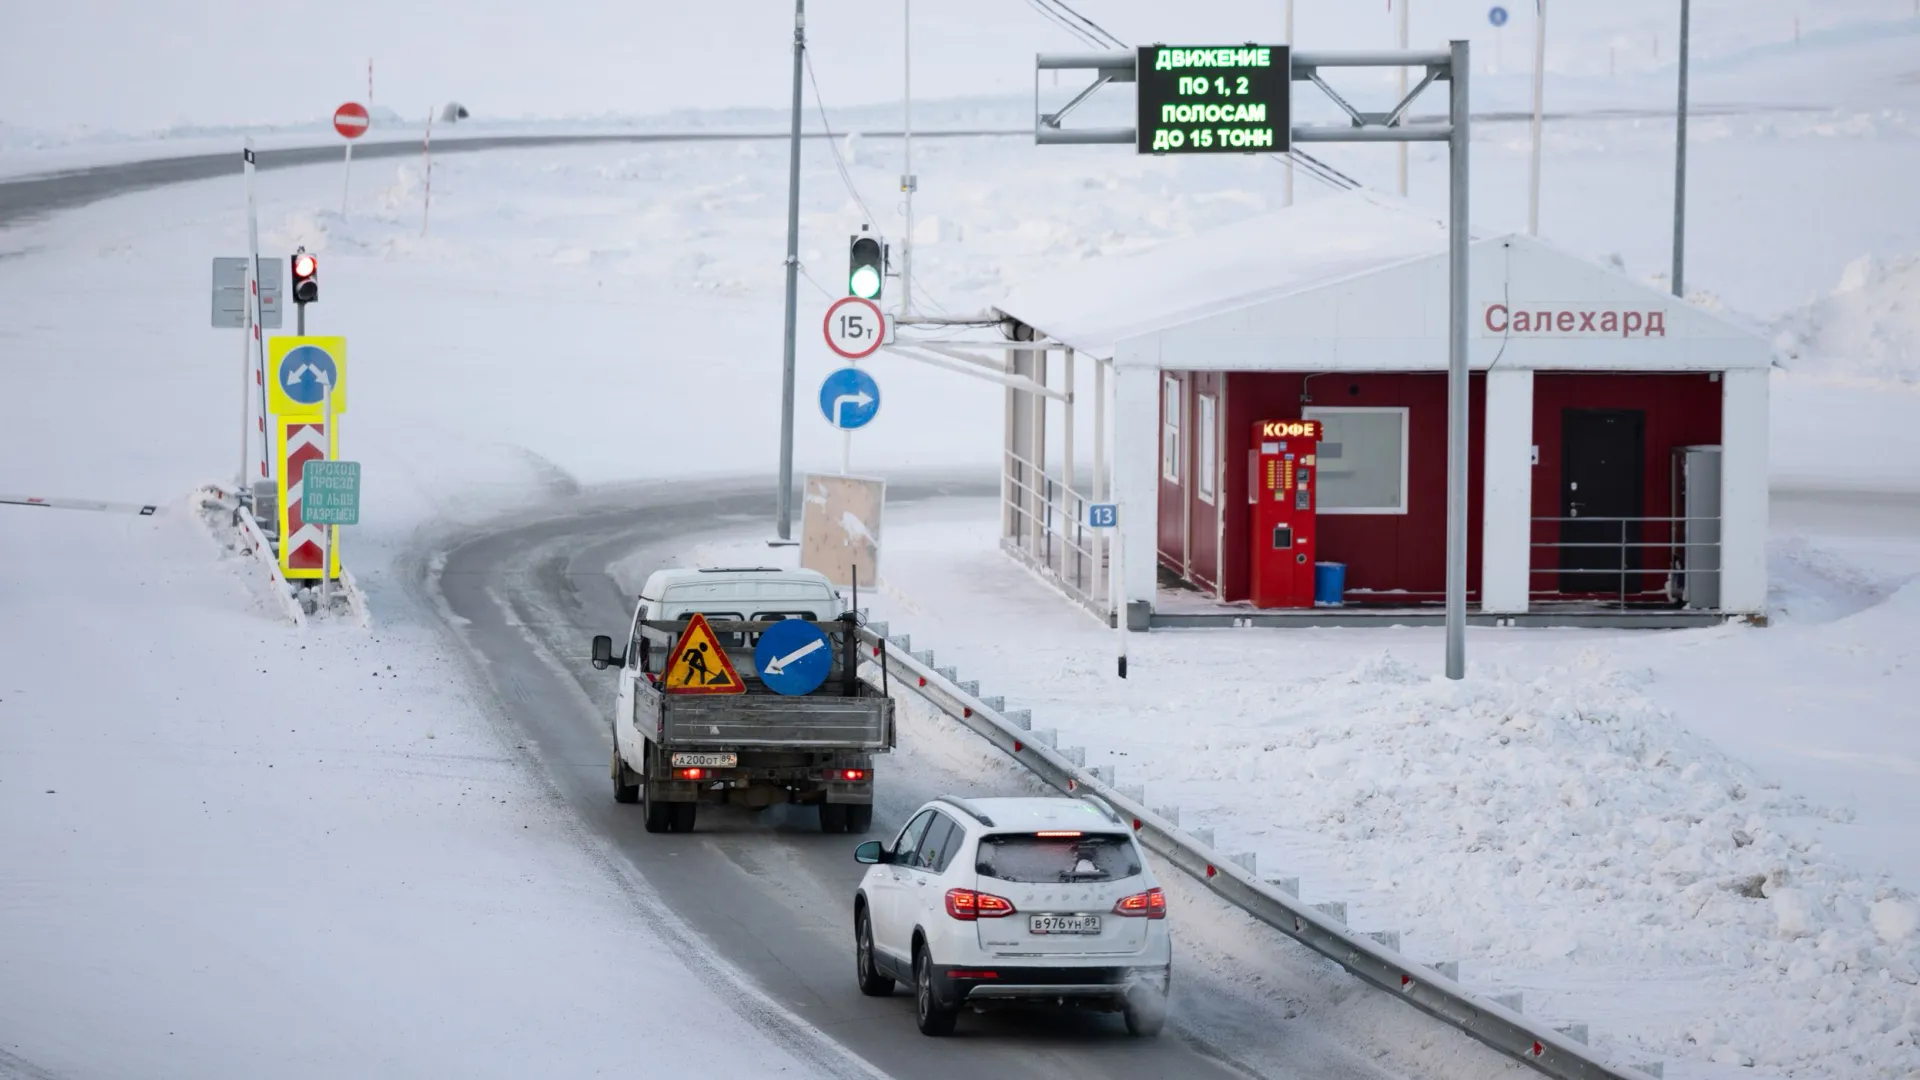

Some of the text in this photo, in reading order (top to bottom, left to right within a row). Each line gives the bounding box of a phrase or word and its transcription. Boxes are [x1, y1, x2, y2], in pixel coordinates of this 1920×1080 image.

[1155, 48, 1271, 71] ДВИЖЕНИЕ
[1178, 76, 1249, 97] ПО 1, 2
[1162, 103, 1266, 123] ПОЛОСАМ
[1152, 128, 1273, 150] ДО 15 ТОНН
[1485, 304, 1665, 338] Салехард
[1263, 422, 1315, 437] КОФЕ
[310, 463, 356, 476] ПРОХОД
[310, 475, 354, 490] ПРОЕЗД
[309, 492, 354, 506] ПО ЛЬДУ
[1094, 507, 1113, 525] 13
[721, 754, 731, 762] 89
[1084, 917, 1096, 928] 89
